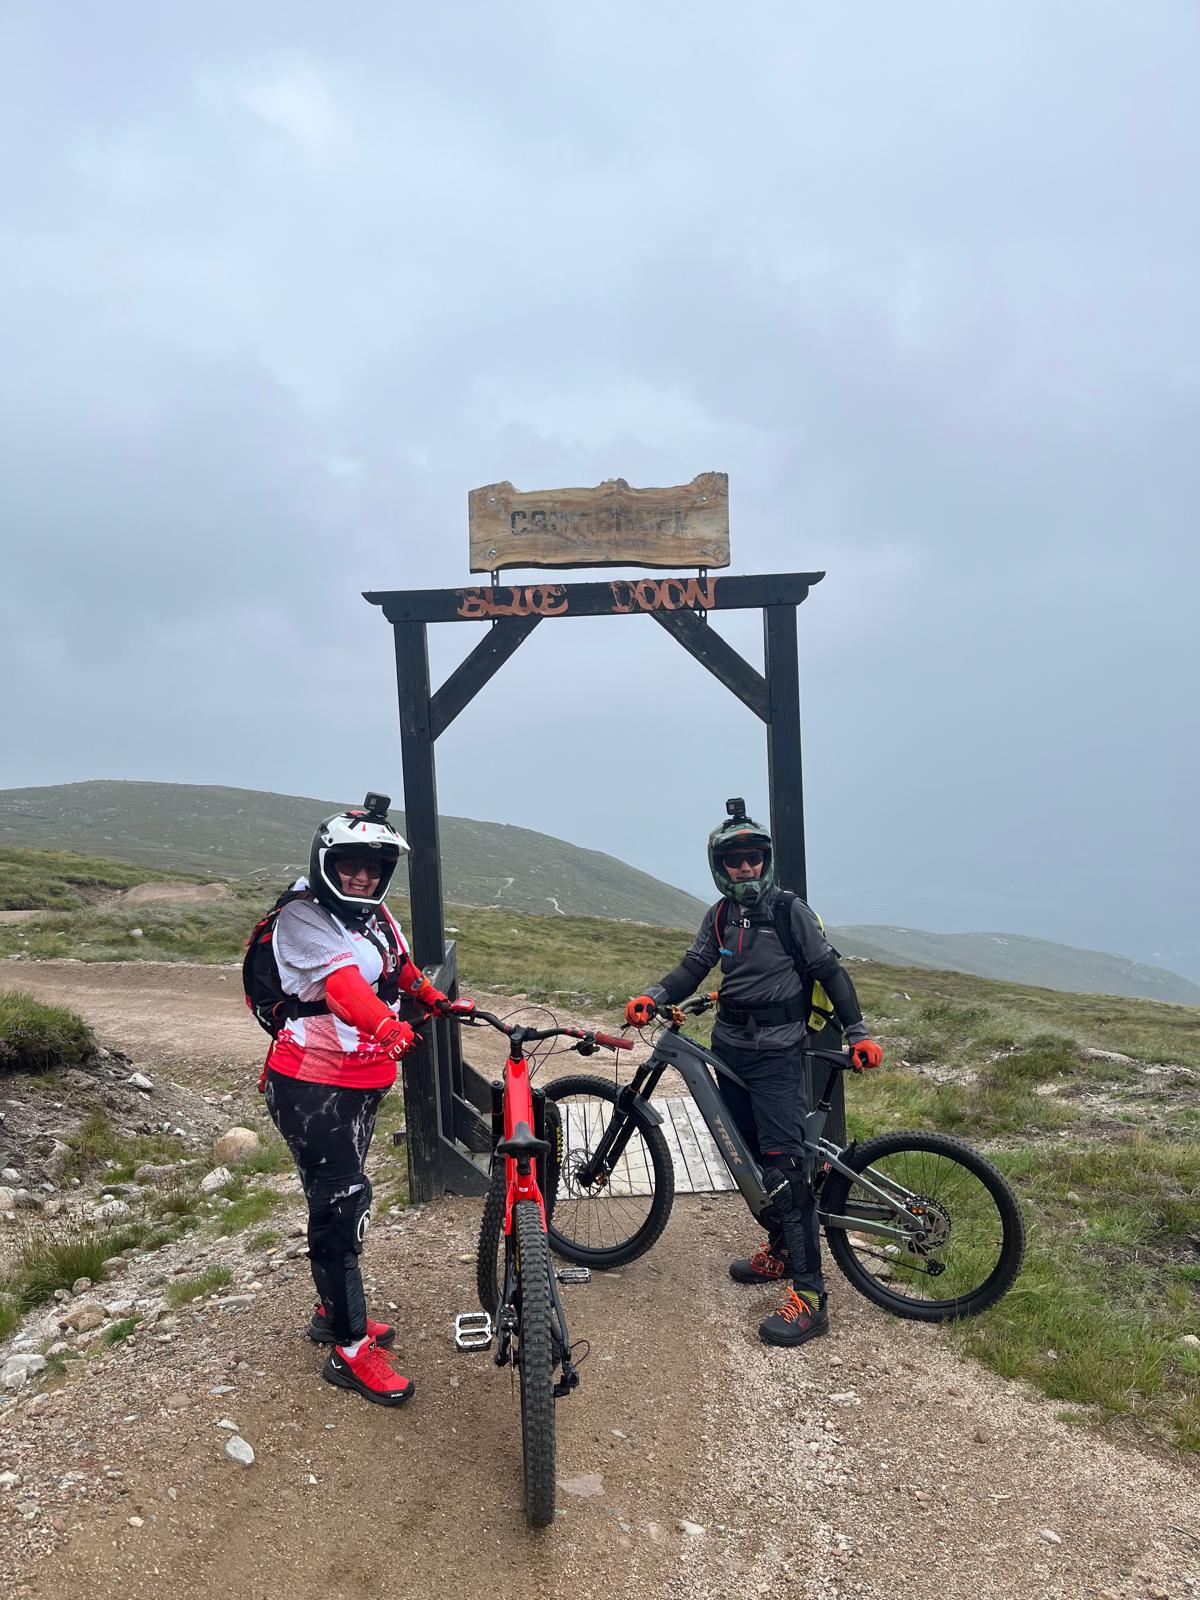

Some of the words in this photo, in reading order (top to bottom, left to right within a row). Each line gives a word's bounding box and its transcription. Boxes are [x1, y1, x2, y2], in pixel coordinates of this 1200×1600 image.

[456, 584, 569, 617] BLUE
[608, 577, 719, 613] DOON
[388, 1037, 408, 1060] FOX
[713, 1113, 743, 1166] TREK
